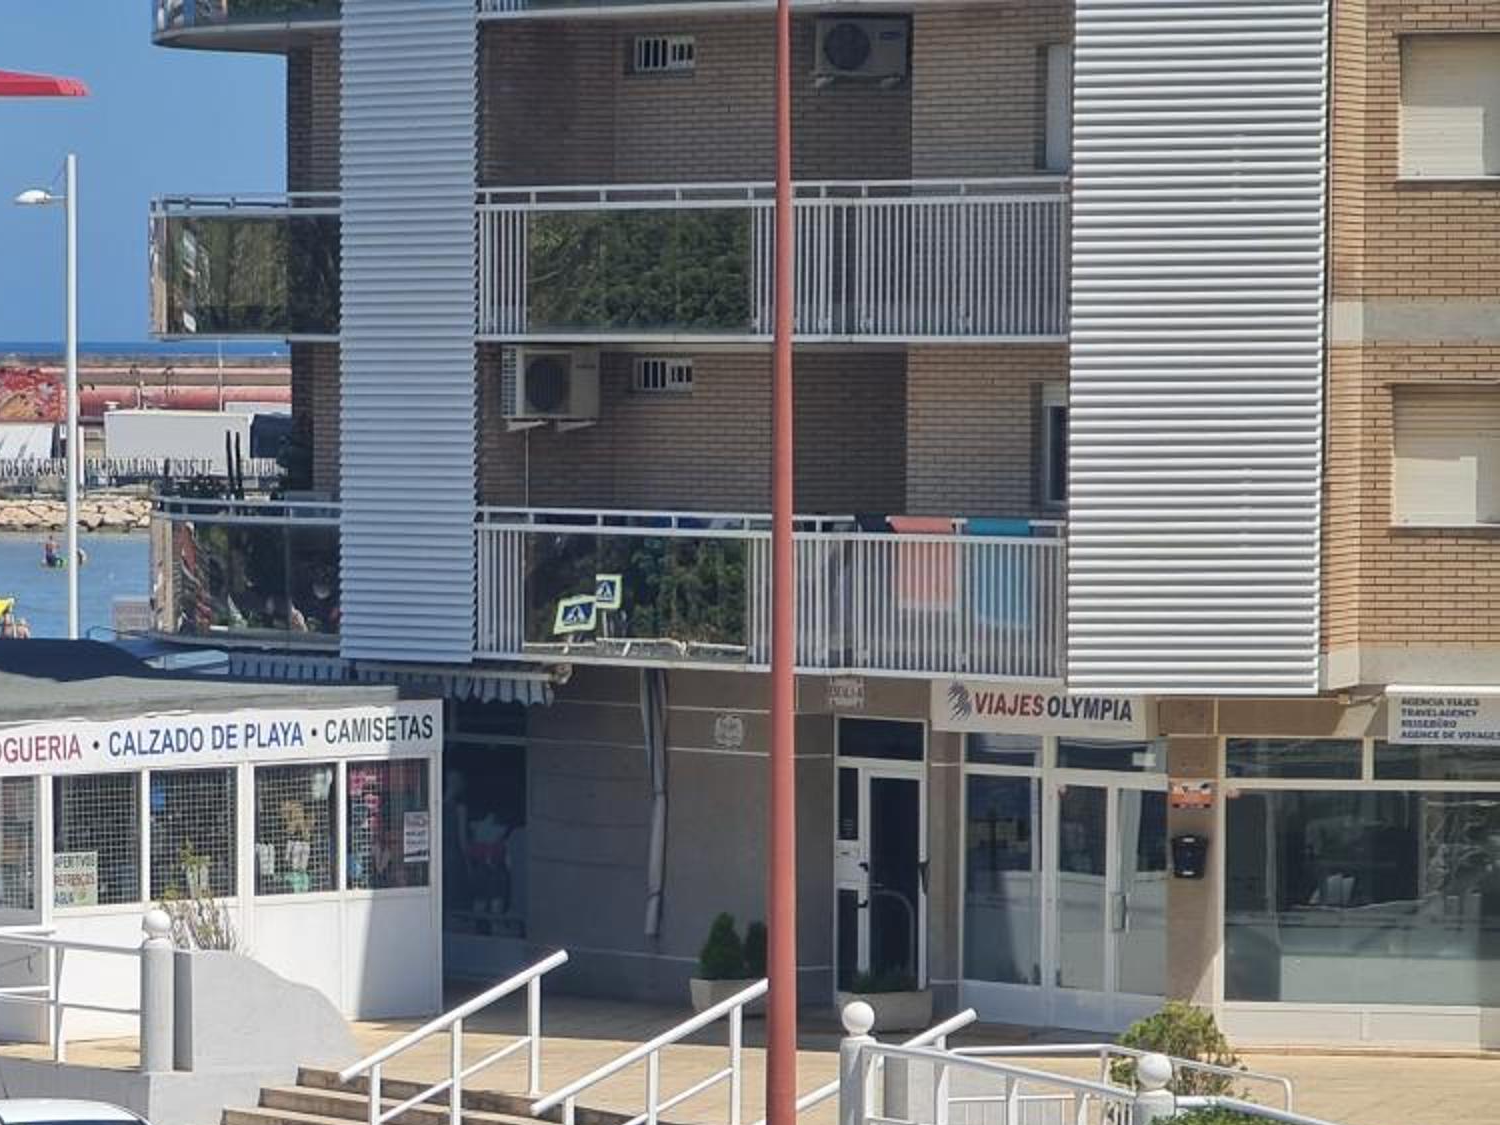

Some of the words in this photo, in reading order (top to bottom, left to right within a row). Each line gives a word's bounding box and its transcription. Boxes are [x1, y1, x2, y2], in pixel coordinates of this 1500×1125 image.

[974, 691, 1045, 717] VIAJES
[1046, 695, 1133, 722] OLYMPIA
[108, 726, 204, 757] CALZADO
[211, 724, 238, 750] DE
[244, 721, 304, 748] PLAYA
[324, 713, 434, 745] CAMISETAS
